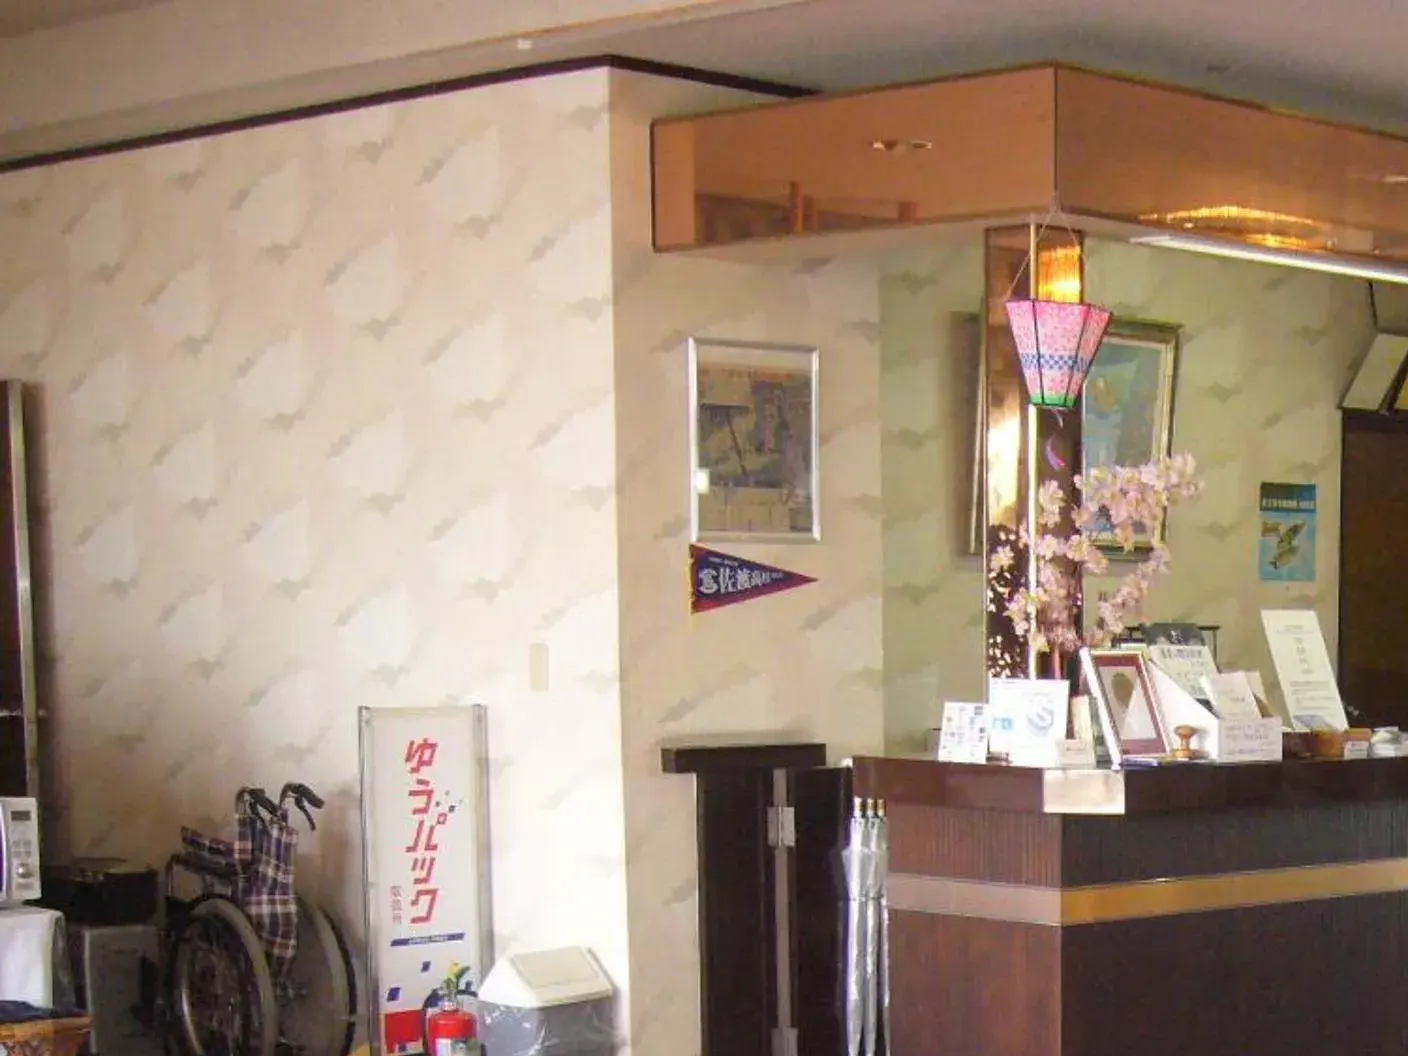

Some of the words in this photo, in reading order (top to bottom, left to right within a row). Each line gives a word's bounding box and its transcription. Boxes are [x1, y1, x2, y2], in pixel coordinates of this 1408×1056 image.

[405, 737, 448, 924] ゆうパック
